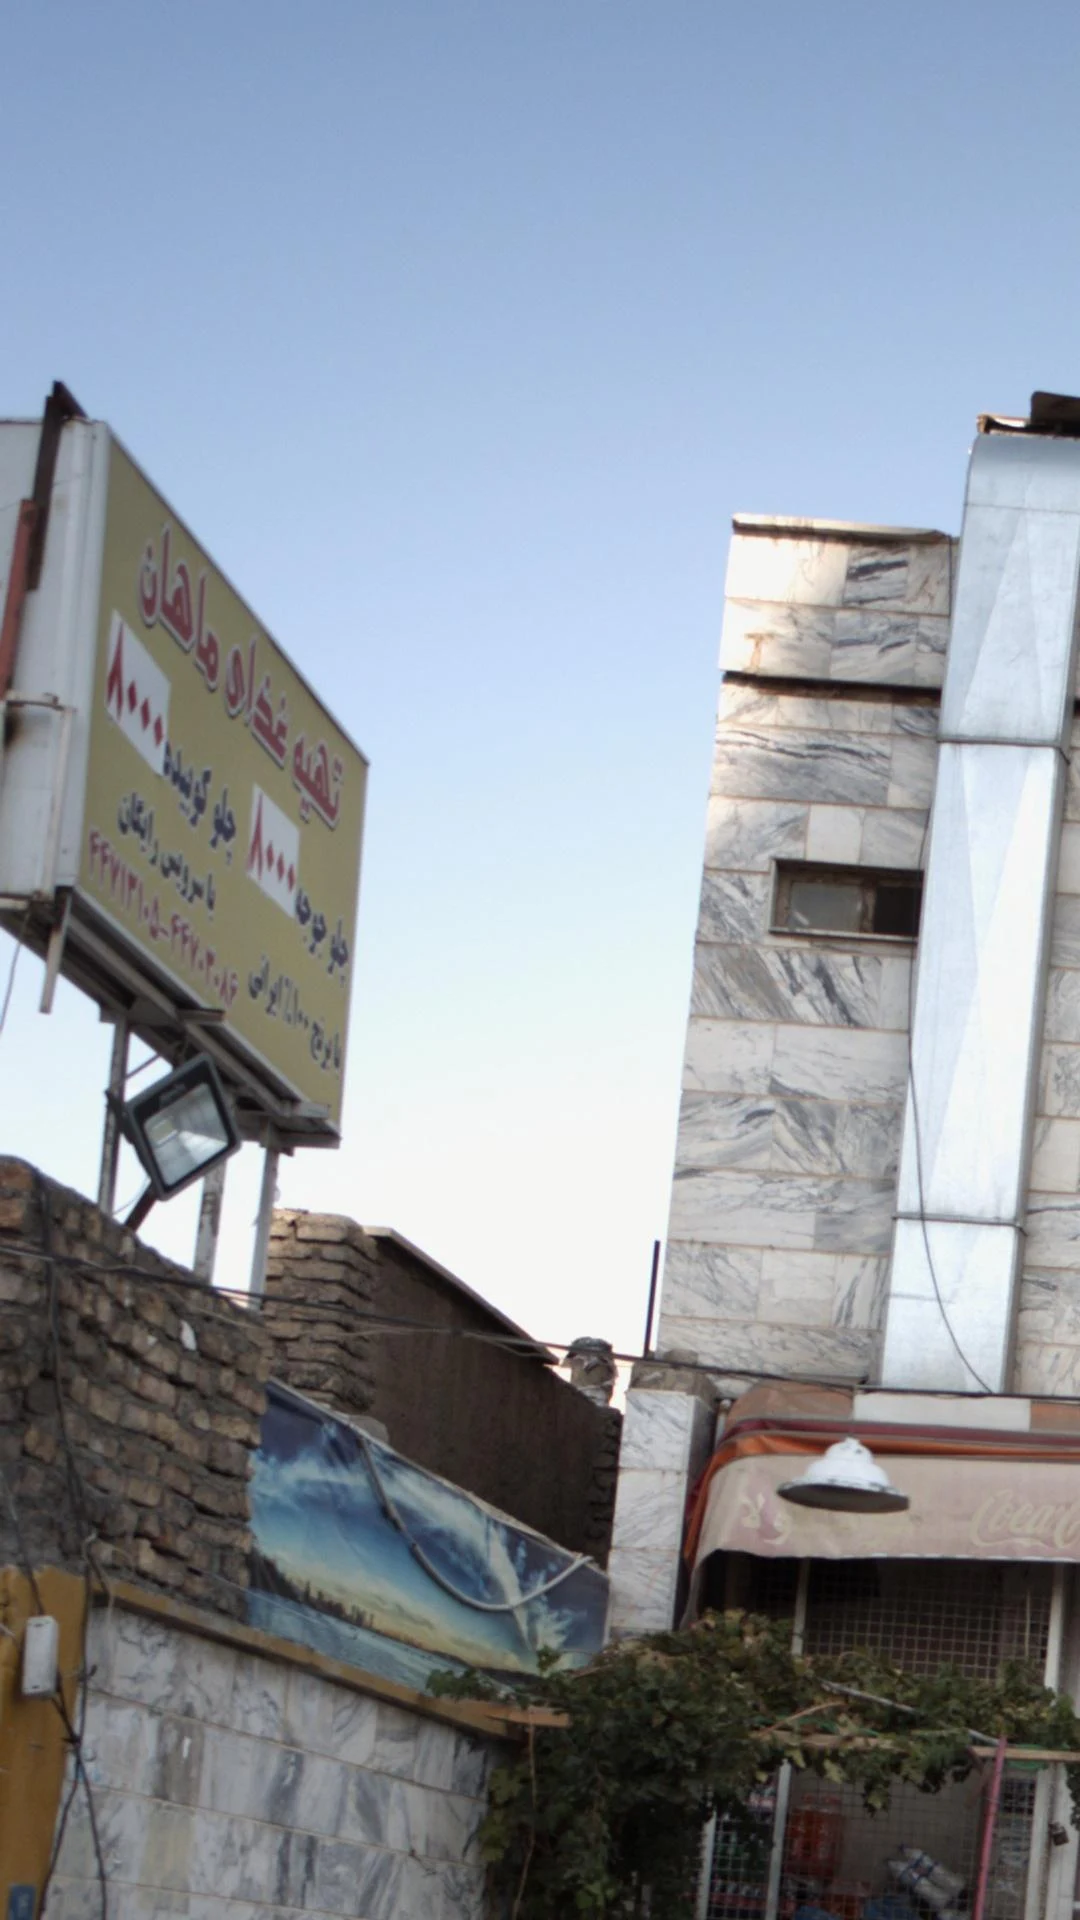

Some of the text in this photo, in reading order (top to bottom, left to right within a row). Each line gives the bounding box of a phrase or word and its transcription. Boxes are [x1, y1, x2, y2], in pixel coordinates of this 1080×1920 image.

[107, 621, 163, 747] ۸۰۰۰
[140, 522, 342, 829] تهیه غذای ماهان
[248, 791, 296, 893] ۸۰۰۰
[295, 889, 327, 959] جوجه
